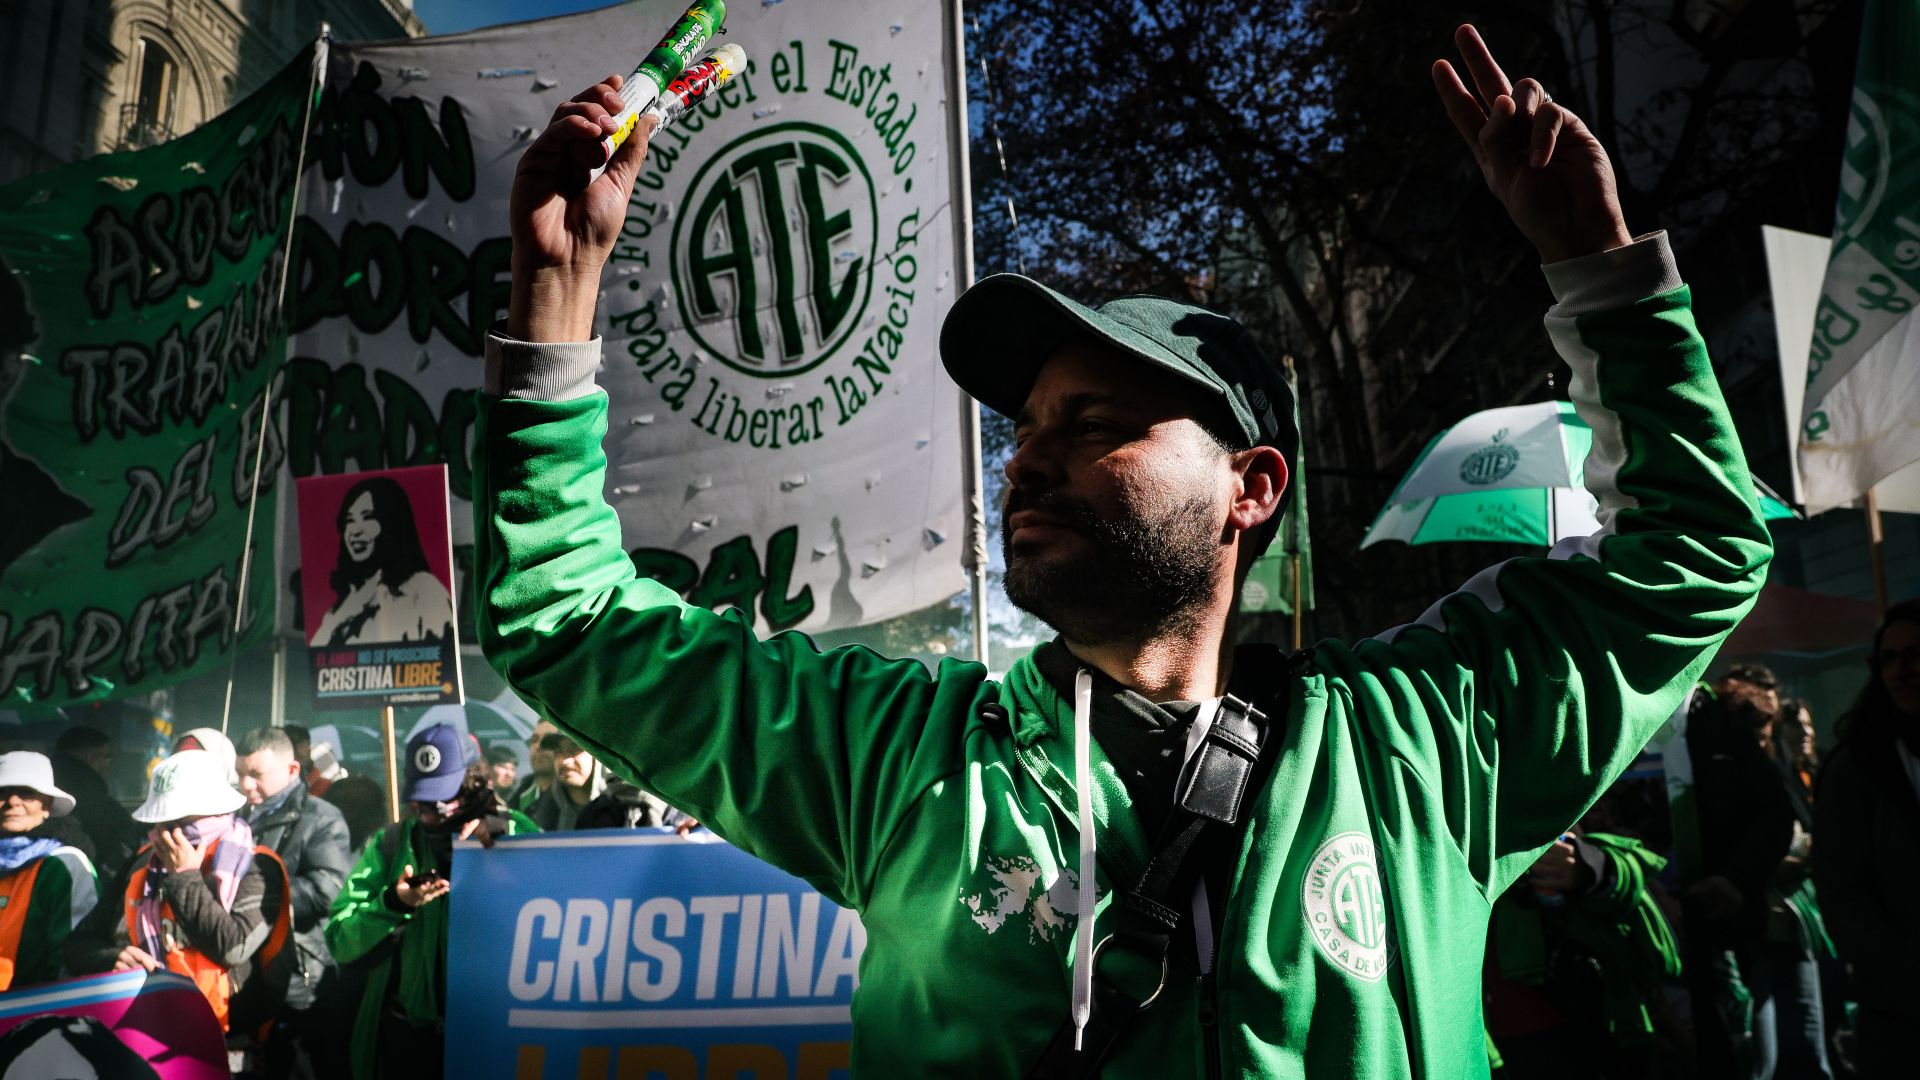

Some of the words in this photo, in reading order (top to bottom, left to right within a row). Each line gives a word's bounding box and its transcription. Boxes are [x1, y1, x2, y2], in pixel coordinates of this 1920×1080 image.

[637, 66, 662, 84] VERDE
[672, 26, 698, 55] BENGALA
[771, 41, 808, 94] el
[824, 39, 917, 177] Estado
[688, 140, 864, 364] ATE
[610, 299, 698, 412] para
[691, 378, 826, 450] liberar
[106, 430, 217, 569] DEL
[318, 664, 394, 693] CRISTINA
[394, 661, 443, 689] LIBRE
[1311, 848, 1345, 900] JUNTA
[1335, 865, 1387, 947] ATE
[507, 891, 868, 1004] CRISTINA
[1315, 911, 1351, 965] CASA
[1355, 955, 1371, 974] DE
